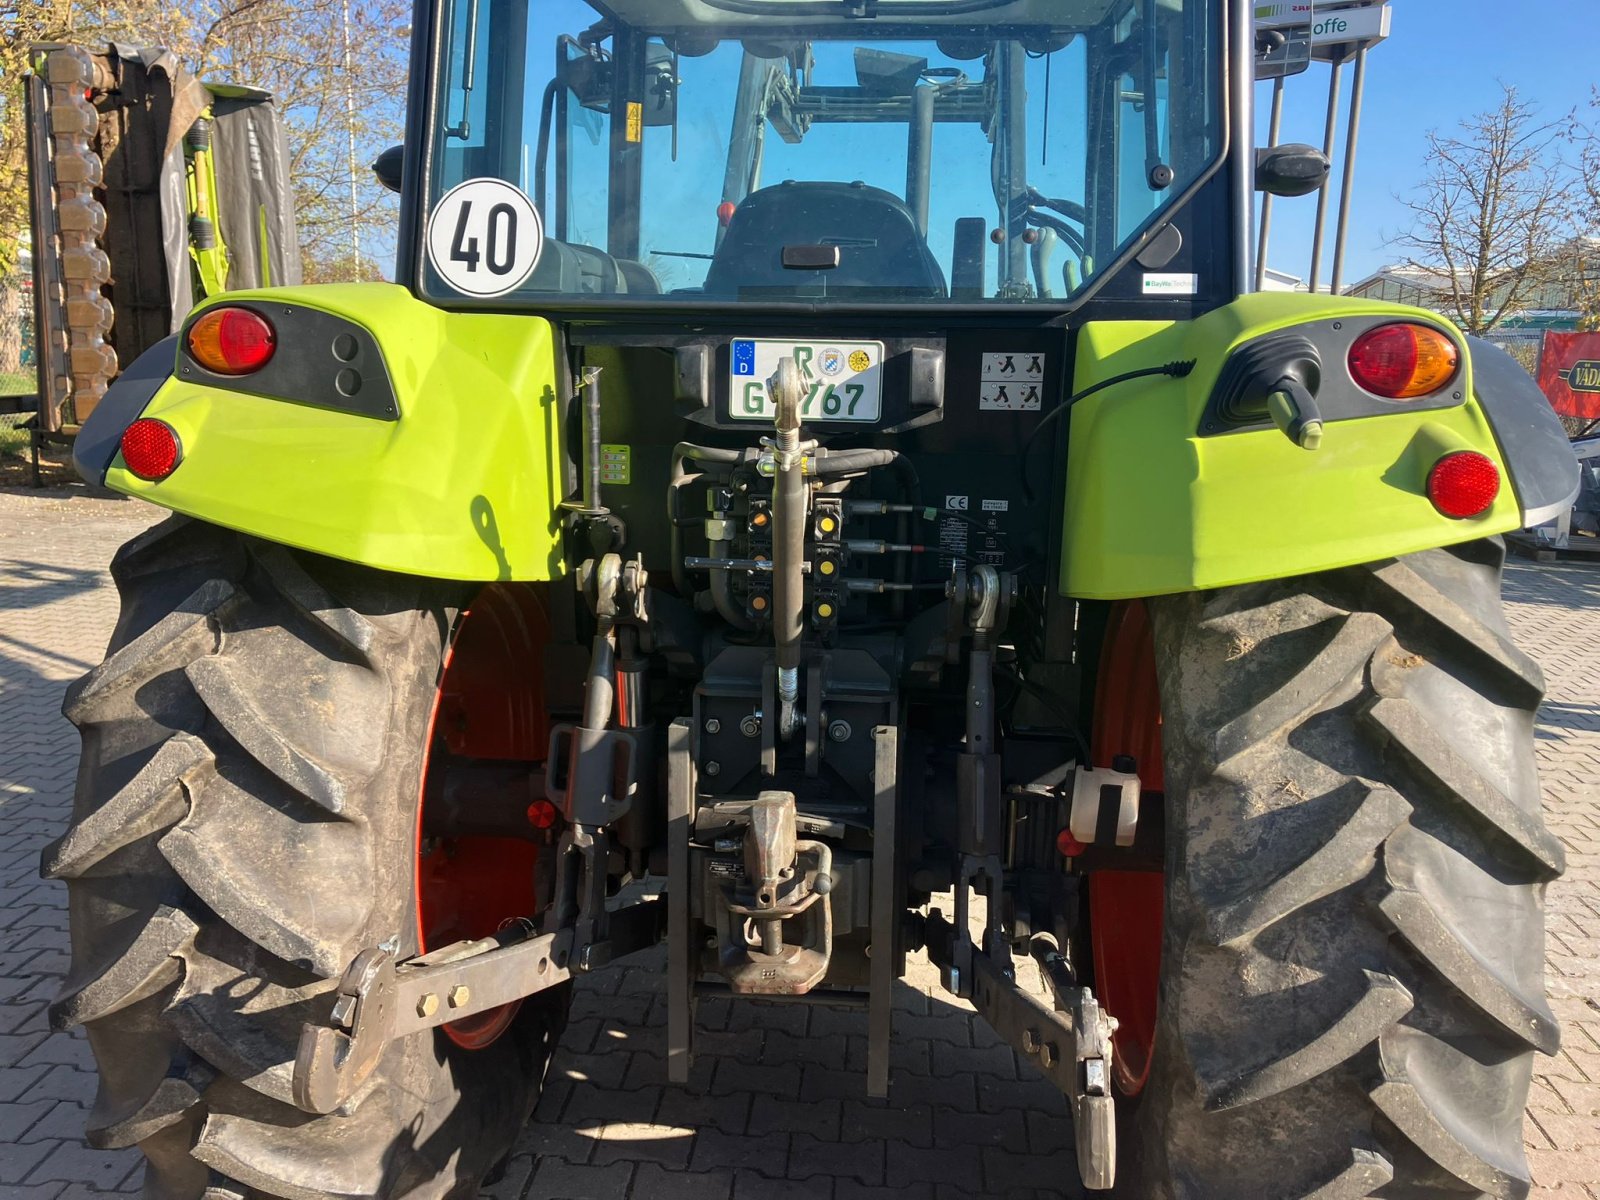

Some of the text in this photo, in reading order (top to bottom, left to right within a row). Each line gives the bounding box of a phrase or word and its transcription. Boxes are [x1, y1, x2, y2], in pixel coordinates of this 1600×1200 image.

[450, 201, 517, 275] 40
[740, 363, 748, 373] D
[793, 347, 814, 378] R
[1576, 363, 1600, 386] VÄD
[743, 382, 764, 413] G
